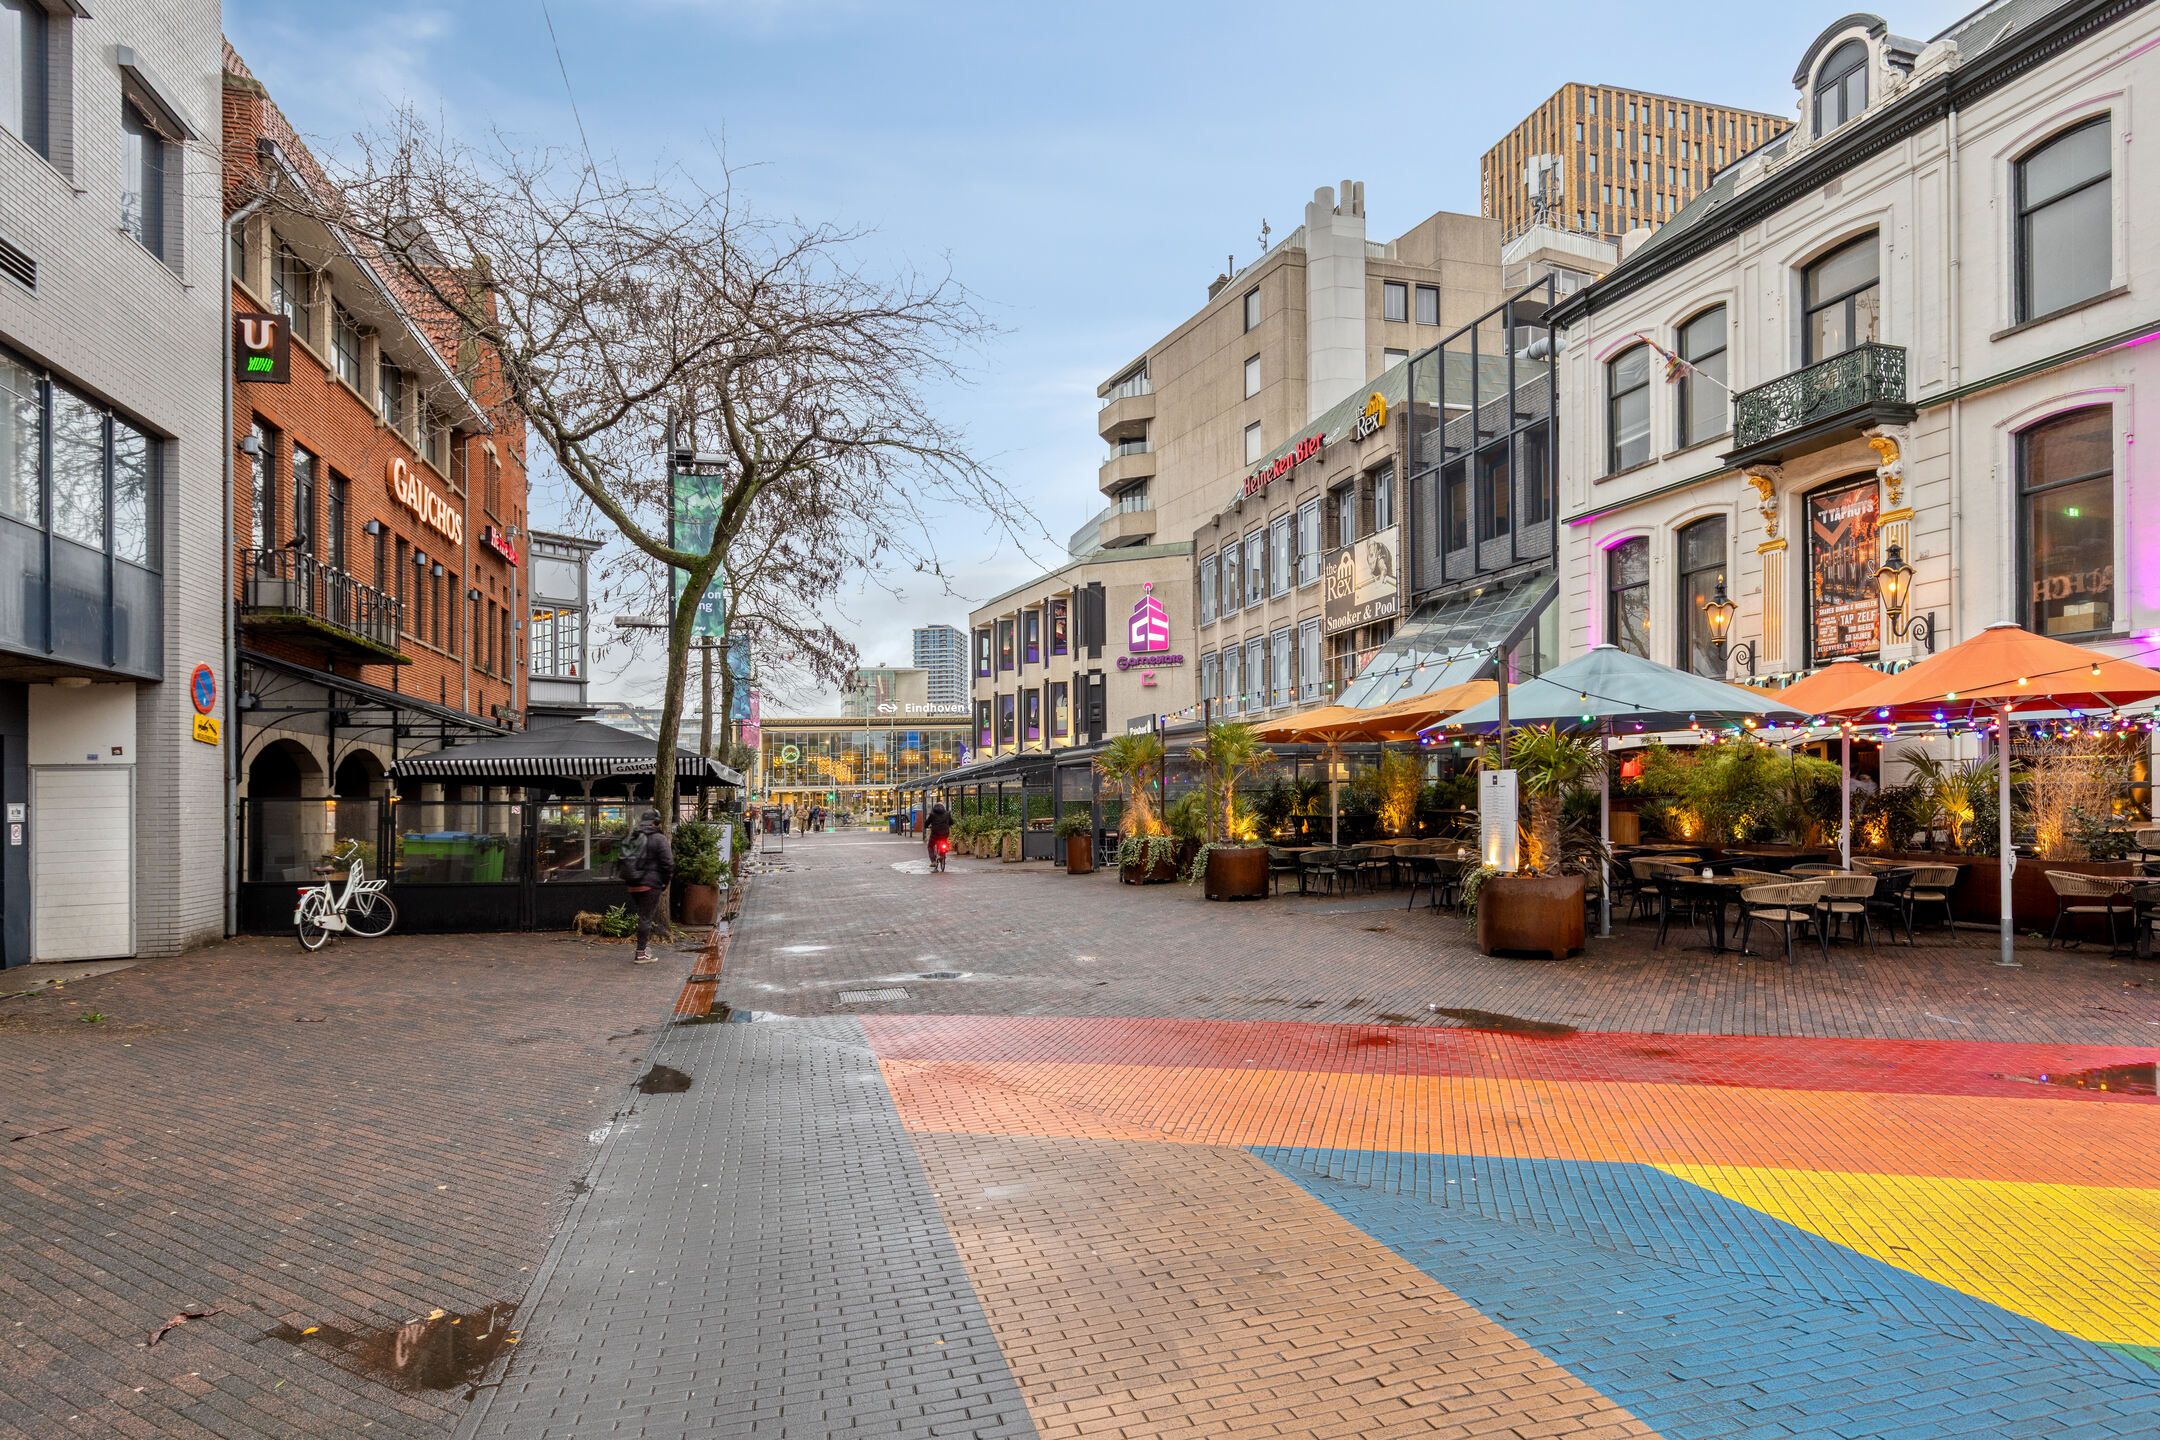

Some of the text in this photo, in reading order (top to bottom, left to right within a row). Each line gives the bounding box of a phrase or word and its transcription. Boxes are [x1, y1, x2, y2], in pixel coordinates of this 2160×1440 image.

[240, 319, 276, 349] U
[1356, 406, 1366, 418] the
[1356, 413, 1379, 441] Rex
[1243, 453, 1294, 498] Heineken
[1294, 432, 1326, 463] Bier
[394, 457, 463, 546] GAUCHOS
[1326, 563, 1337, 576] the
[709, 591, 721, 600] on
[1326, 576, 1352, 602] Rex
[1327, 596, 1396, 630] Snooker & Pool
[1840, 609, 1877, 625] TAP ZELF
[905, 703, 965, 713] Eindhoven
[616, 763, 657, 772] GAUCH
